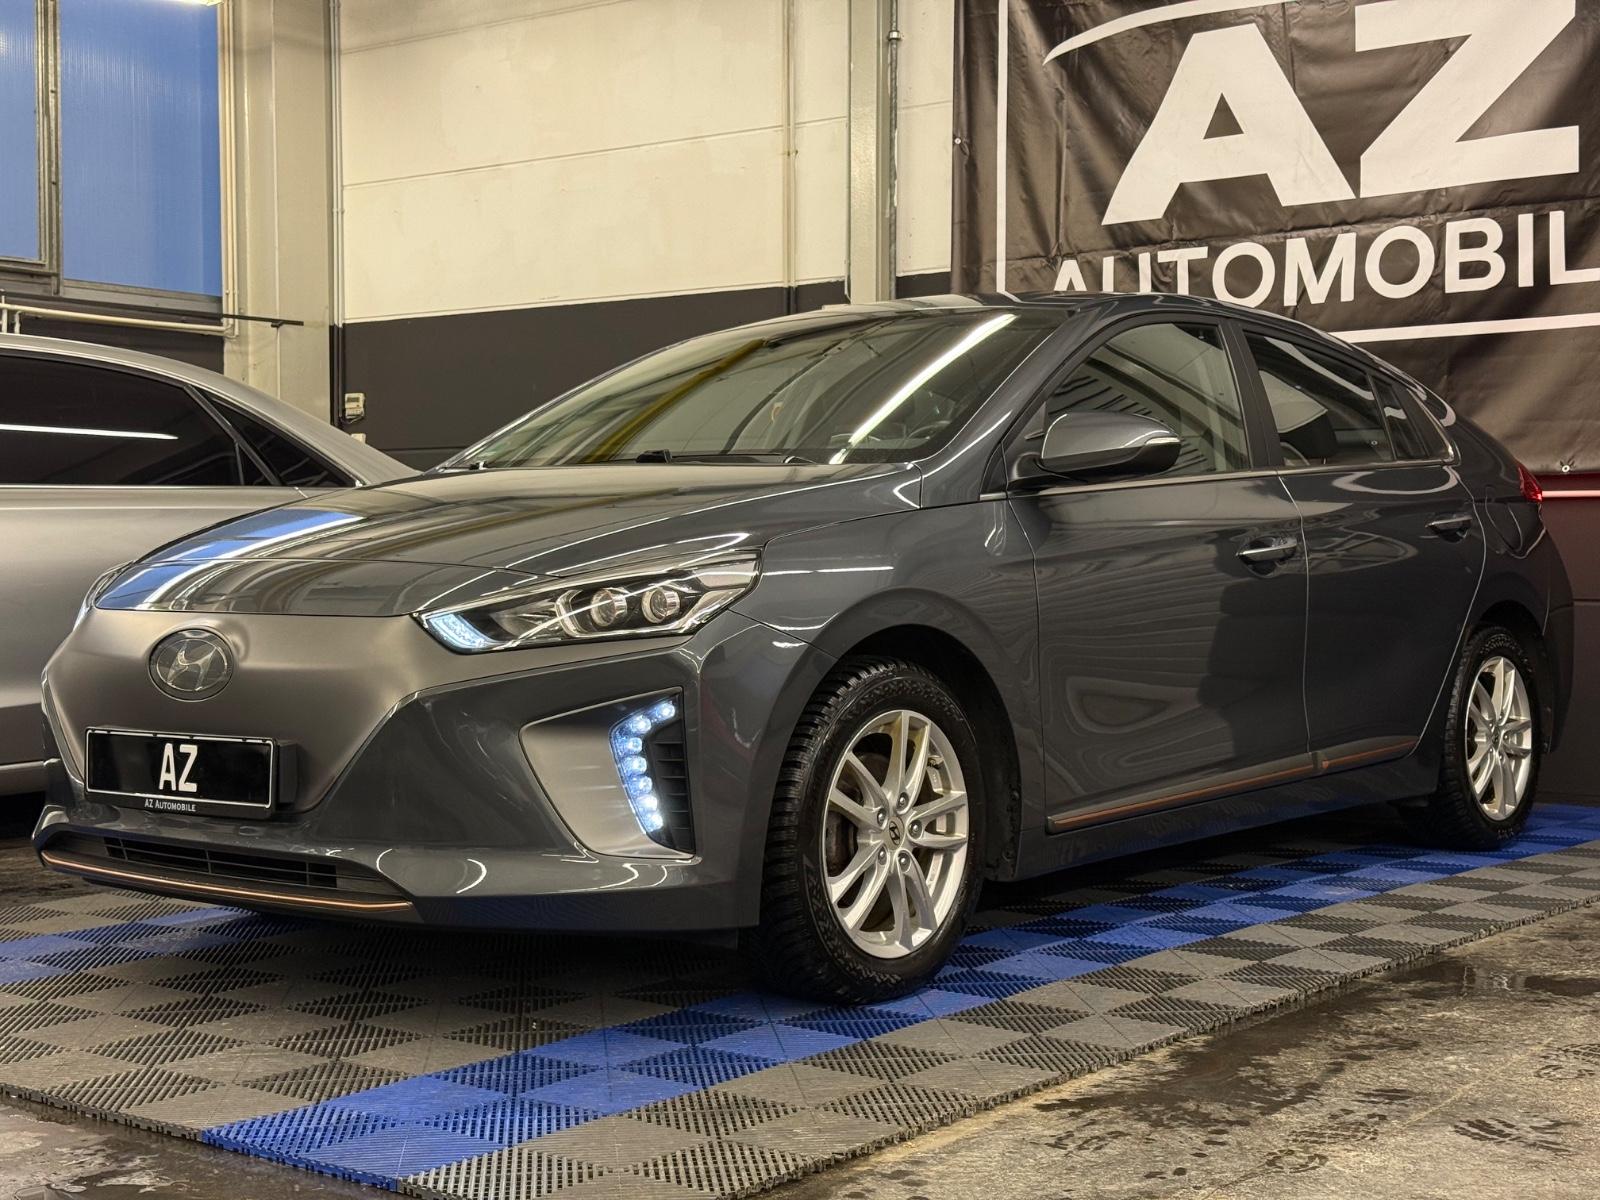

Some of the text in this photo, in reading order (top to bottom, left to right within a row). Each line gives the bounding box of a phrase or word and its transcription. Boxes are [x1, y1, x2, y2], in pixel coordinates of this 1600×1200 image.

[1102, 0, 1580, 225] AZ
[159, 743, 198, 792] AZ
[144, 799, 197, 812] AZ AUTOMOBILE
